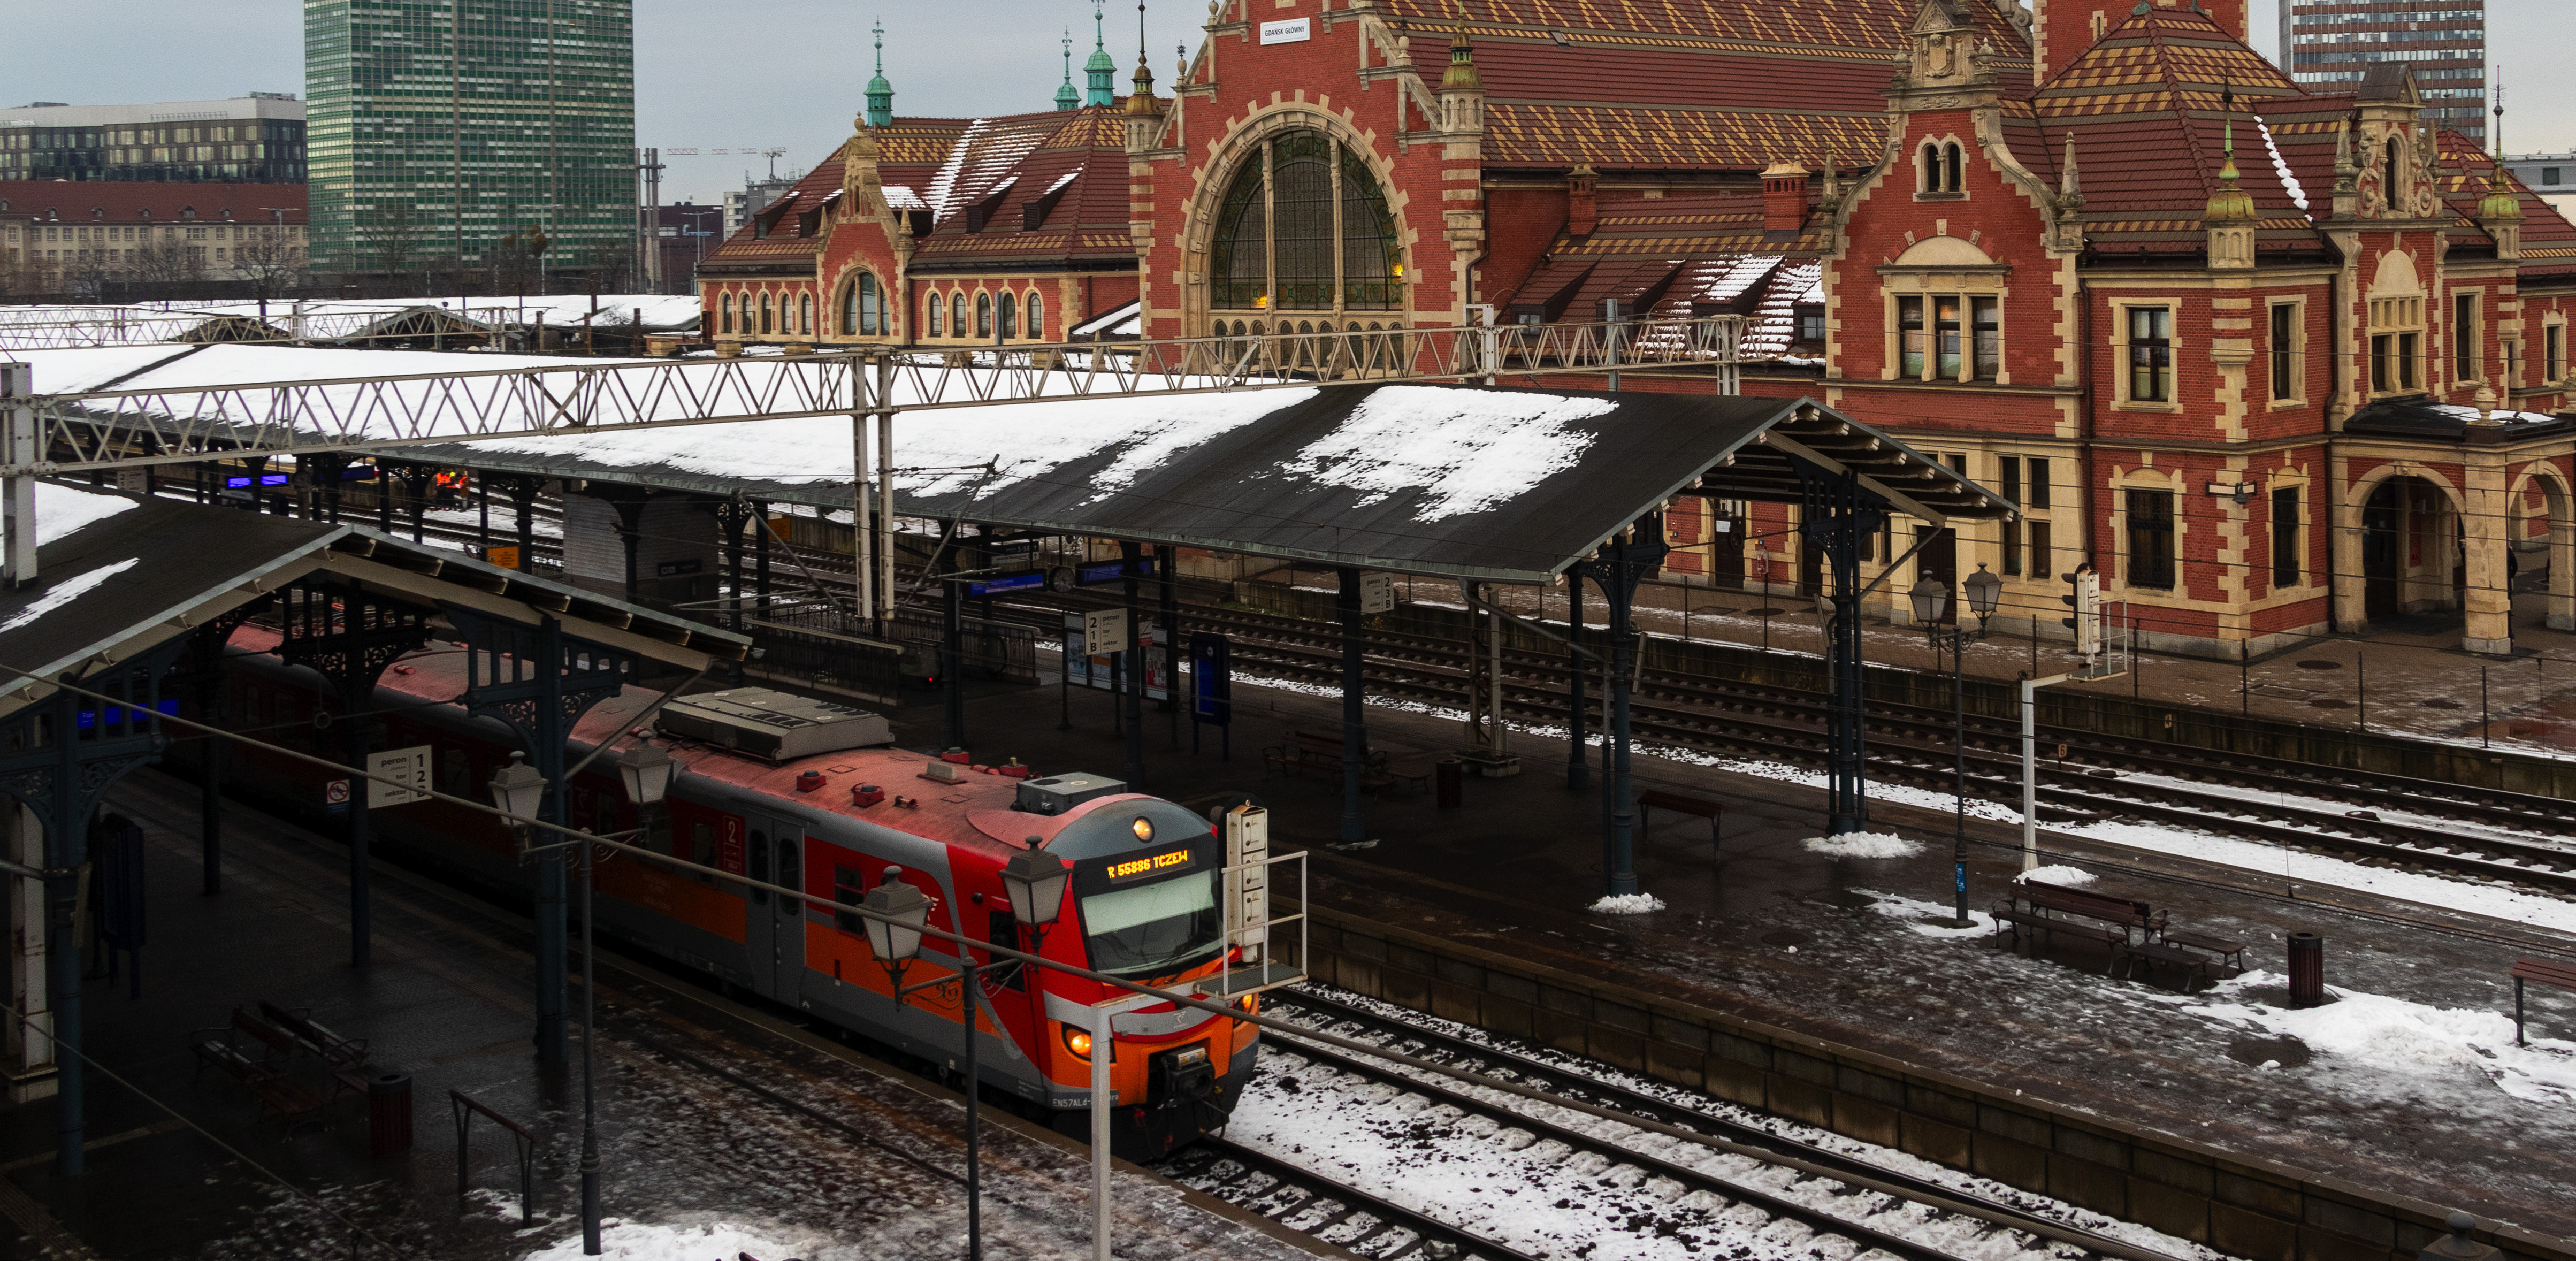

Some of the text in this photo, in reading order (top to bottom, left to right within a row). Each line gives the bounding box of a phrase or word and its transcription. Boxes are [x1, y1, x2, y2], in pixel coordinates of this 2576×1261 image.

[1265, 26, 1304, 36] GDAŃSK GŁÓWNY
[1385, 577, 1390, 587] 2
[1386, 589, 1390, 597] 3
[1386, 600, 1390, 608] B
[1090, 617, 1097, 628] 2
[1091, 631, 1095, 640] 1
[1091, 643, 1096, 652] B
[381, 754, 423, 767] peron 1
[417, 770, 425, 782] 2
[384, 789, 407, 797] sektor
[728, 821, 736, 843] 2
[1107, 850, 1188, 878] R 55886 TCZEW
